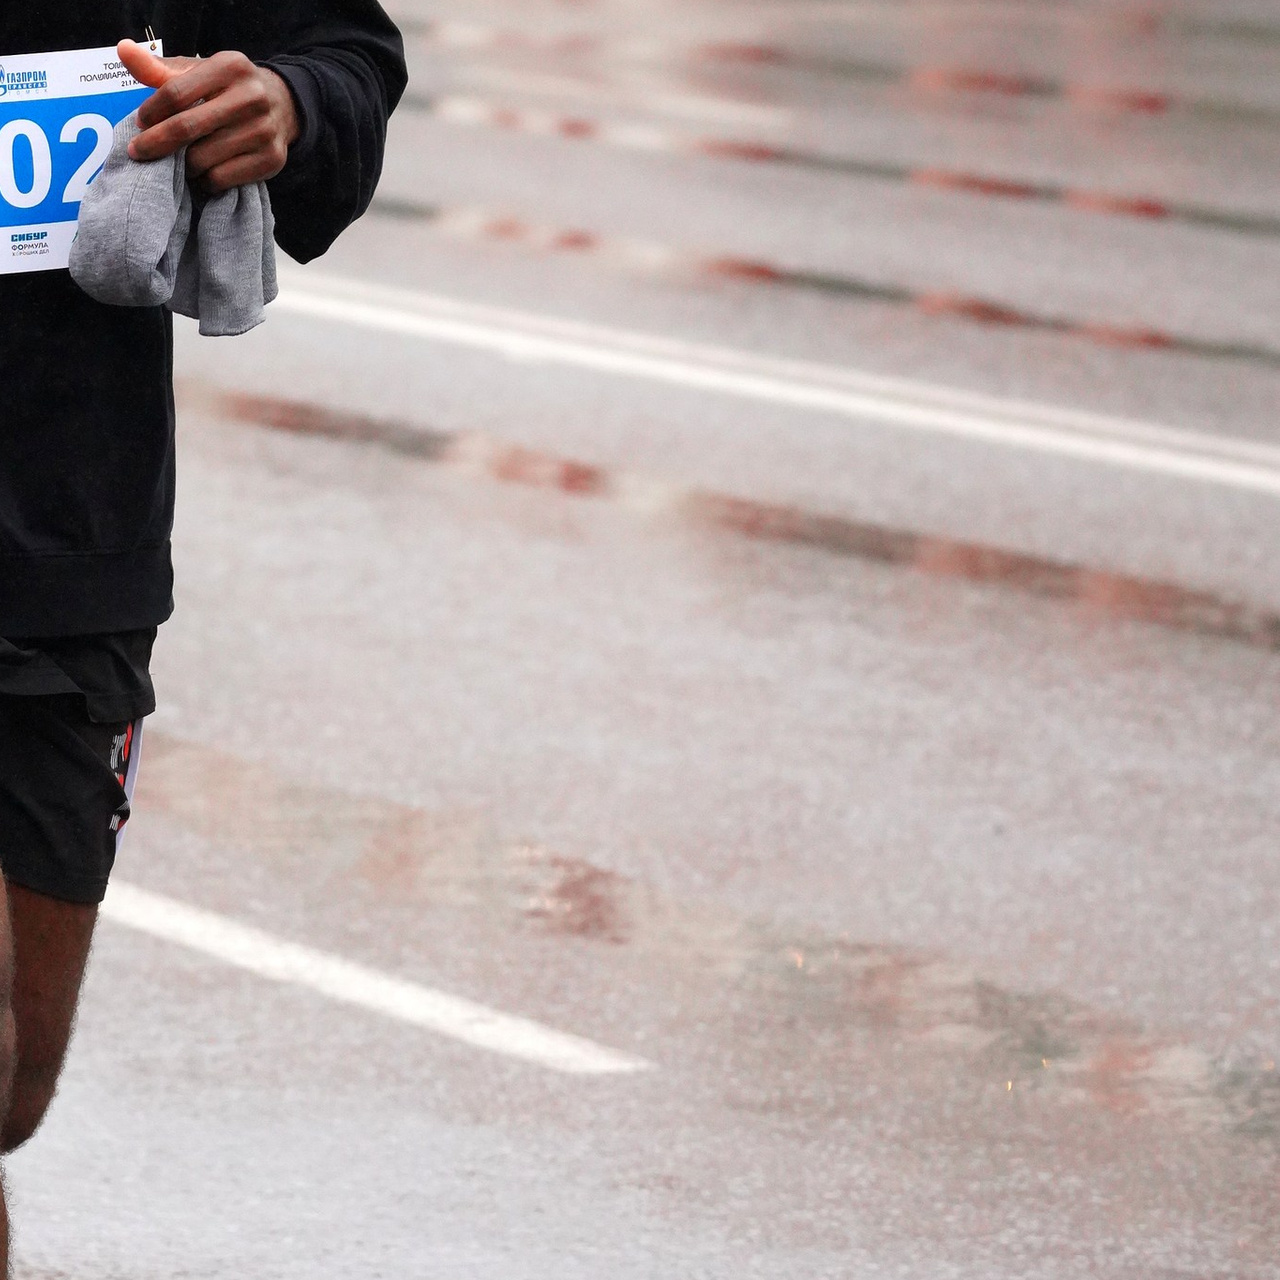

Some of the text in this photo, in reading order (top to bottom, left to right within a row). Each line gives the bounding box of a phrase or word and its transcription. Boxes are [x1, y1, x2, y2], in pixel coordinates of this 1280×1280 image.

[7, 70, 47, 83] ГАЗПРОМ
[80, 71, 131, 82] ПОЛУМАРАФ
[11, 231, 48, 242] СИБУР
[11, 242, 49, 251] ФОРМУЛА
